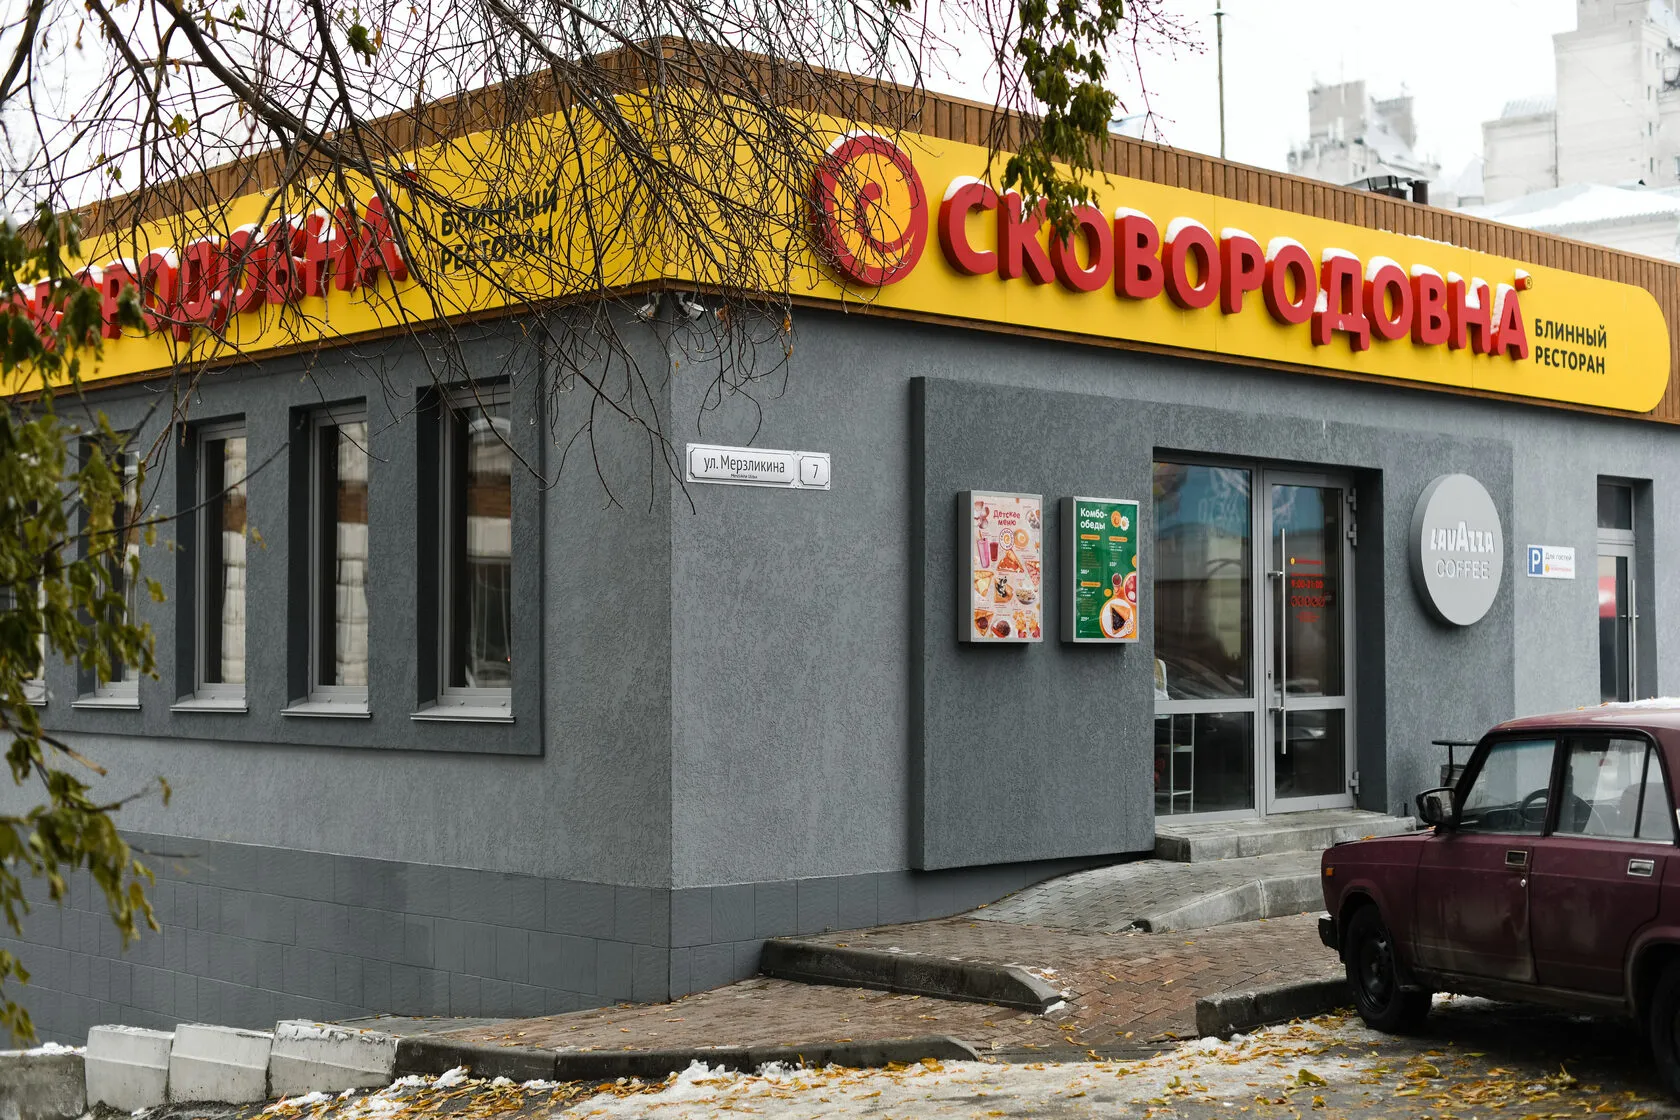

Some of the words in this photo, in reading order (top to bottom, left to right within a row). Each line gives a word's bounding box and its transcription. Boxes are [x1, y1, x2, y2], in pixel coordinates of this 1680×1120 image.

[938, 178, 1529, 360] СКОВОРОДОВНА
[1535, 318, 1607, 349] БЛИННЫЙ
[1535, 345, 1605, 375] РЕСТОРАН
[703, 457, 719, 473] ул.
[720, 454, 785, 474] Мерзликина
[812, 464, 819, 479] 7
[993, 510, 1021, 519] Детское
[1080, 508, 1108, 519] Комбо-
[1080, 519, 1106, 531] обеды
[1430, 521, 1495, 553] LAVAZZA
[1435, 558, 1490, 579] COFFEE
[1532, 549, 1541, 573] P
